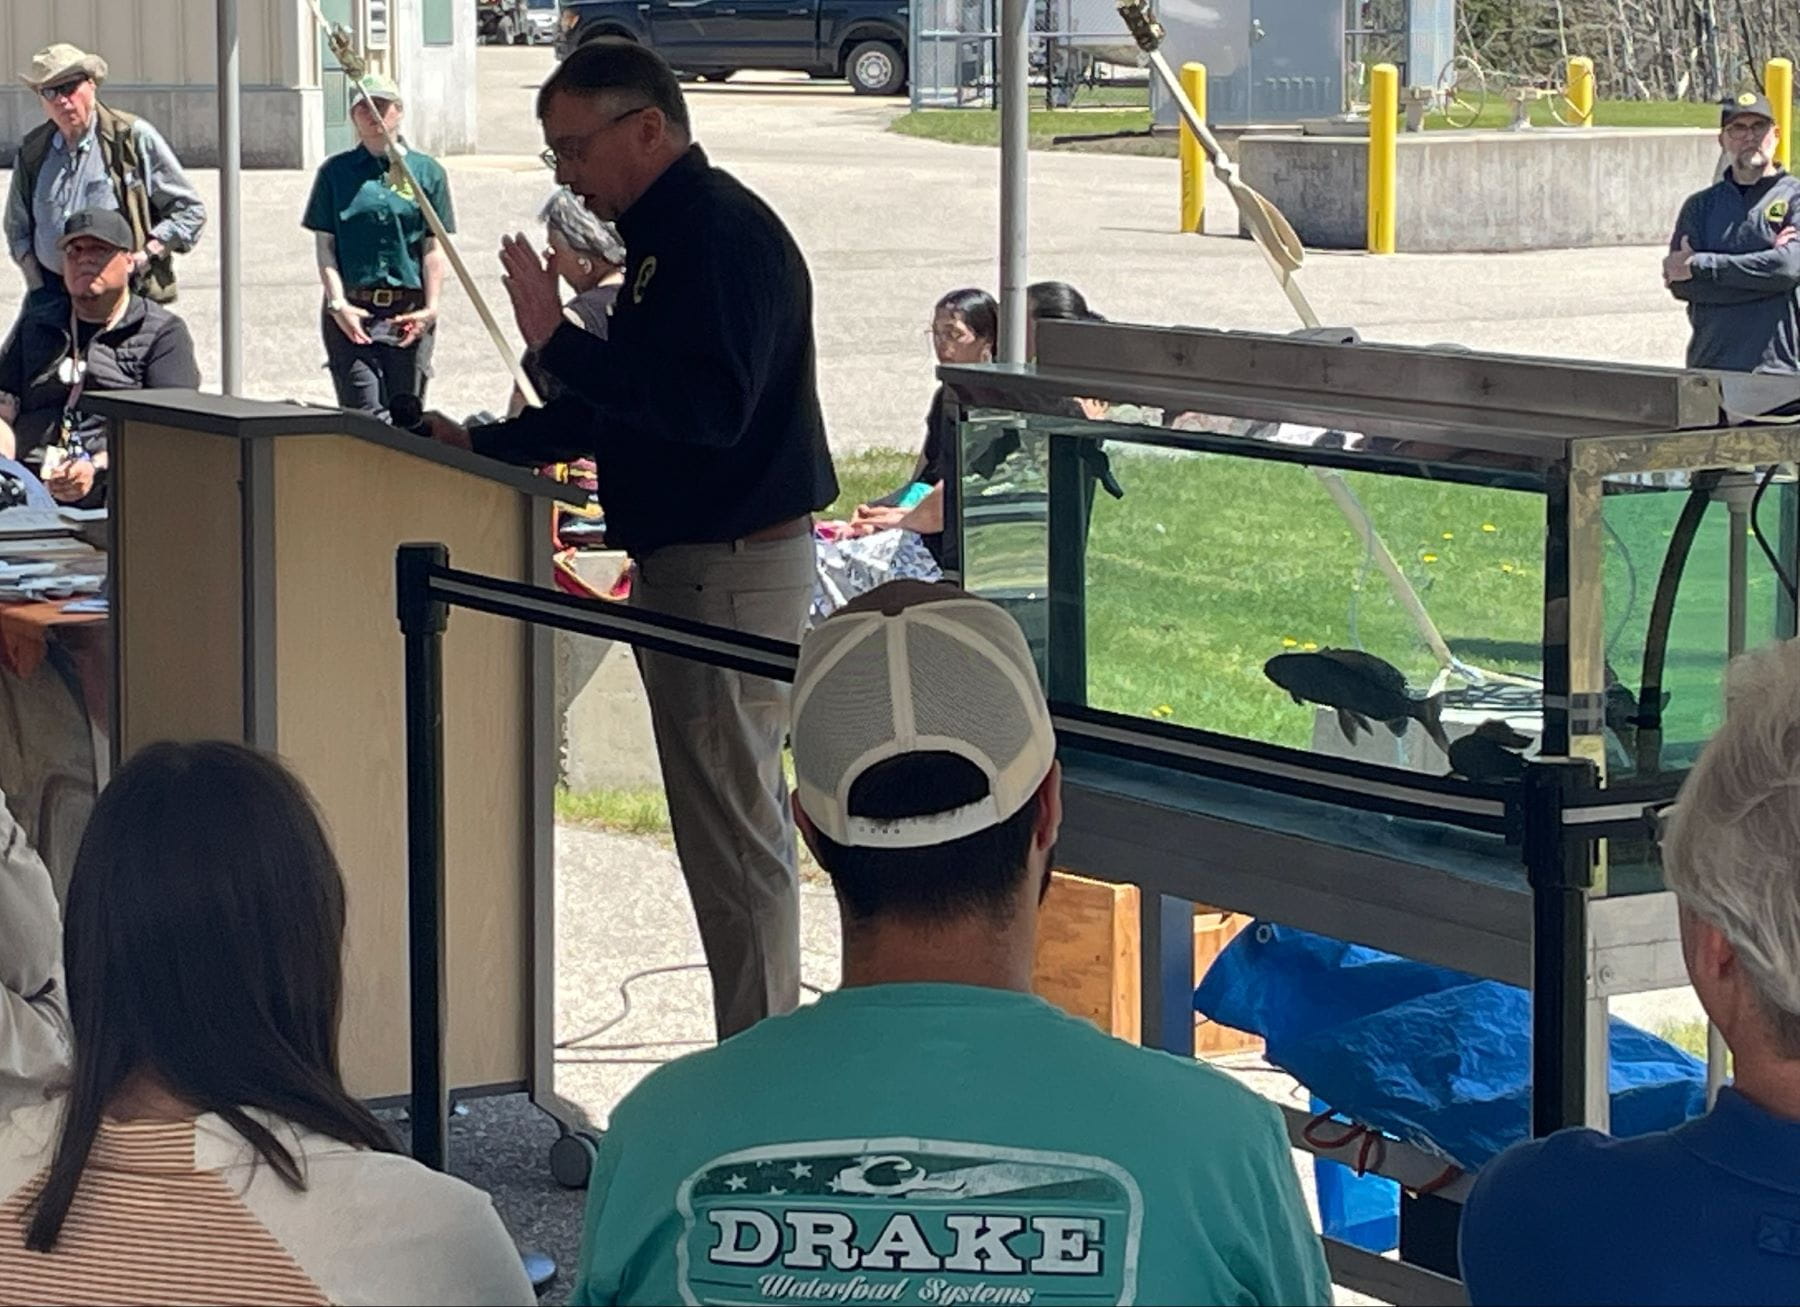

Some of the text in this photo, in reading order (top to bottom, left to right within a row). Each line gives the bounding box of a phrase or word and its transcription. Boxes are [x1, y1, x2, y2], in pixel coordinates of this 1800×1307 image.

[708, 1209, 1104, 1275] DRAKE
[758, 1274, 1035, 1305] Waterfowl Systems
